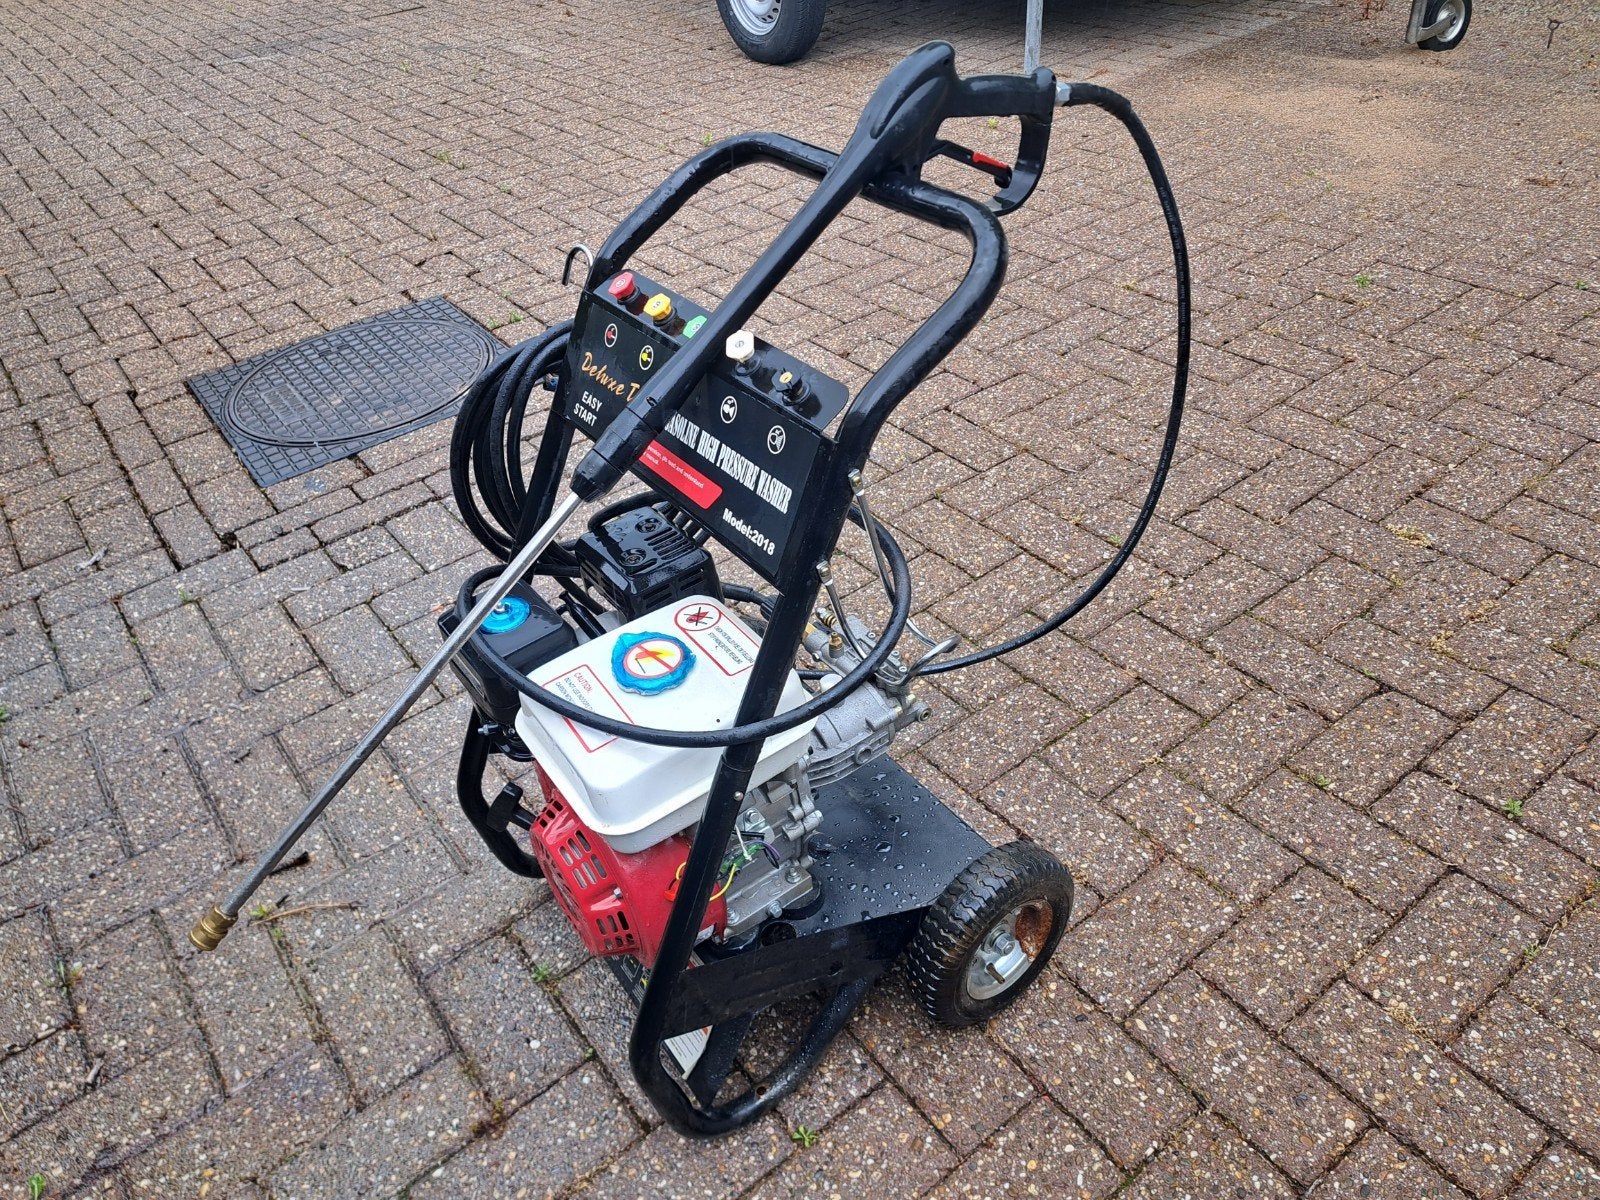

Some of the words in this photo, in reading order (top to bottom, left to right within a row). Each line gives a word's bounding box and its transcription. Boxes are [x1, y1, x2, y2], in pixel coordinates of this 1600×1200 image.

[581, 351, 625, 396] Deluxe
[626, 382, 641, 402] T
[581, 390, 603, 412] EASY
[573, 402, 598, 427] START
[664, 411, 700, 450] ASOLINE
[696, 429, 721, 464] HIGH
[716, 443, 760, 492] PRESSURE
[755, 469, 793, 515] WASHER
[722, 507, 776, 556] Model:2018
